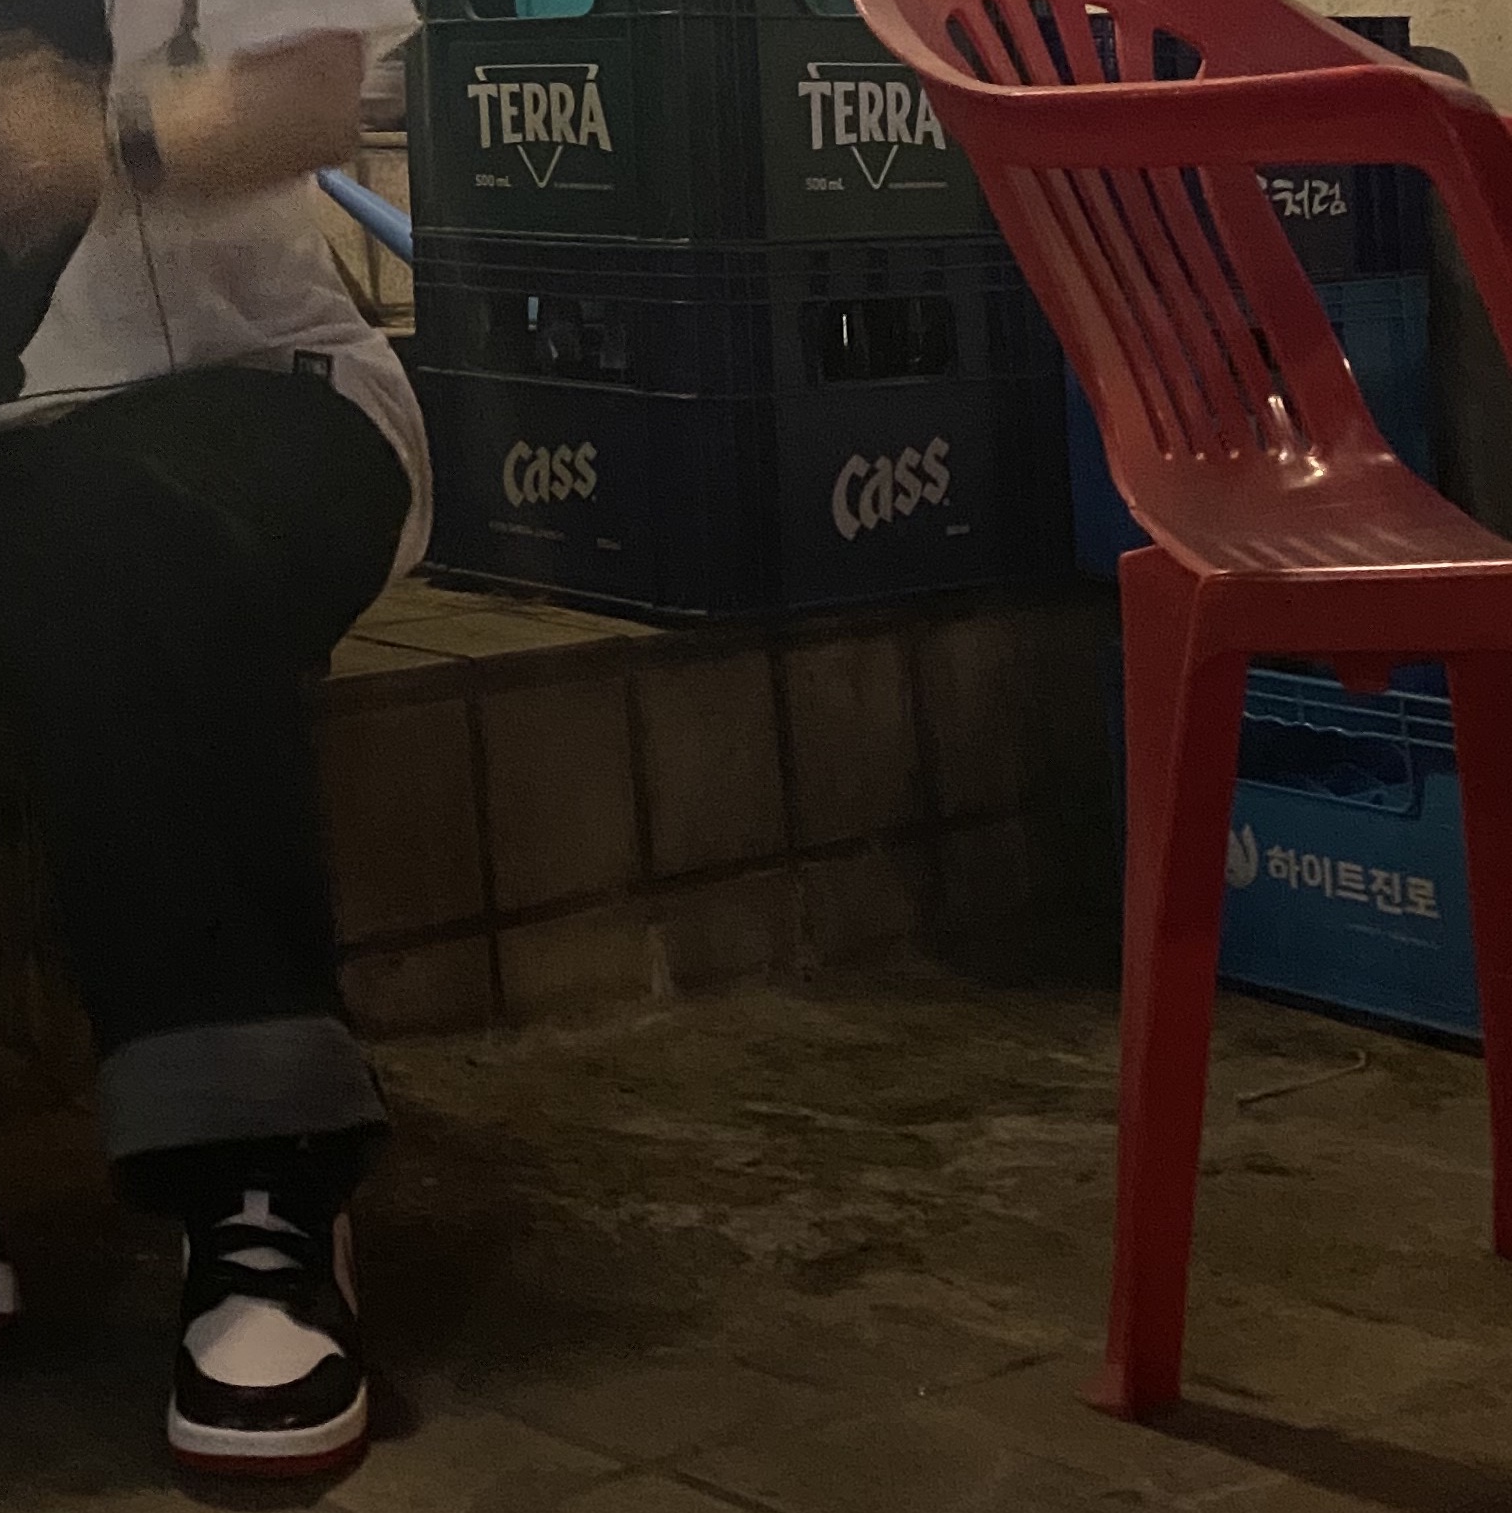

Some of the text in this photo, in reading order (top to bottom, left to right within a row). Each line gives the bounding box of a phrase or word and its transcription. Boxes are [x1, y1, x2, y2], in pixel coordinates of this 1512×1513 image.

[467, 82, 613, 152] TERRA
[798, 81, 947, 151] TERRA
[1256, 174, 1348, 219] 처럼
[503, 440, 598, 508] Cass
[832, 436, 951, 541] Cass
[1266, 844, 1440, 919] 하이트진로
